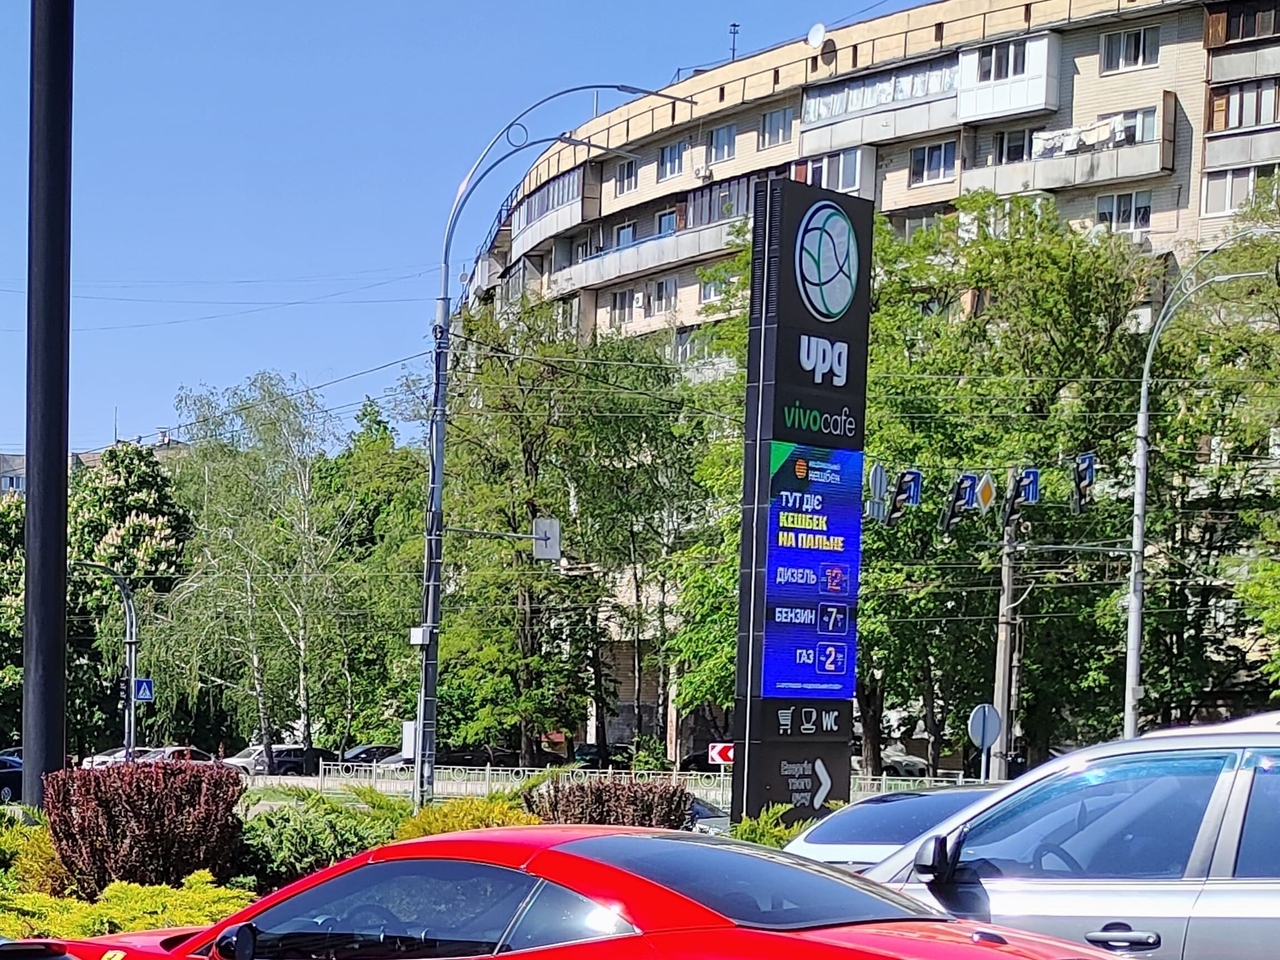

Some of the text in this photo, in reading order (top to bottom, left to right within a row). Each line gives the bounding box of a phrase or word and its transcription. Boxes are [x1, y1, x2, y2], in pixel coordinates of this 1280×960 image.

[799, 334, 849, 387] upg
[780, 491, 822, 512] ТУТ ДІЄ
[779, 511, 827, 531] КЕШБЕК
[778, 531, 845, 551] НА ПАЛЬНЕ
[776, 566, 817, 584] ДИЗЕЛЬ
[775, 607, 816, 624] БЕНЗИН
[796, 649, 814, 664] ГАЗ
[822, 711, 839, 731] WC
